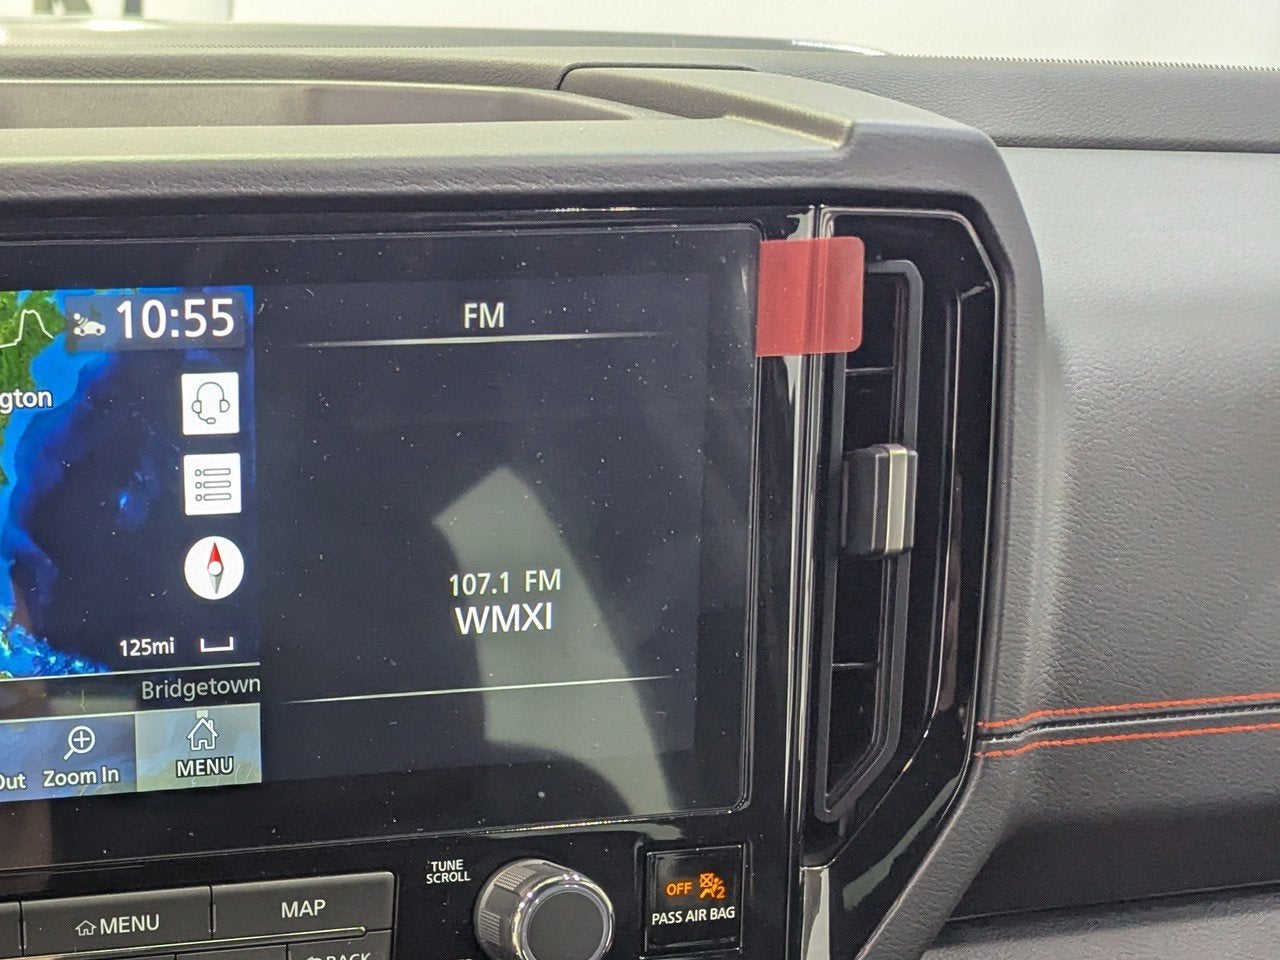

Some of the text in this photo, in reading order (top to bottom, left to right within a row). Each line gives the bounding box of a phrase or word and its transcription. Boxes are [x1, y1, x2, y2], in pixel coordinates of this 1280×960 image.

[117, 298, 234, 339] 10:55
[463, 302, 505, 329] FM
[449, 569, 562, 597] 107.1 FM
[454, 603, 553, 634] WMXI
[119, 638, 175, 657] 125mi
[142, 676, 260, 700] Bridgetown
[44, 767, 119, 787] Zoom In
[176, 757, 233, 777] MENU
[431, 860, 464, 873] TUNE
[426, 870, 471, 884] SCROLL
[666, 882, 692, 896] OFF
[281, 899, 326, 919] MAP
[651, 906, 736, 925] PASS AIR BAG
[100, 914, 160, 936] MENU
